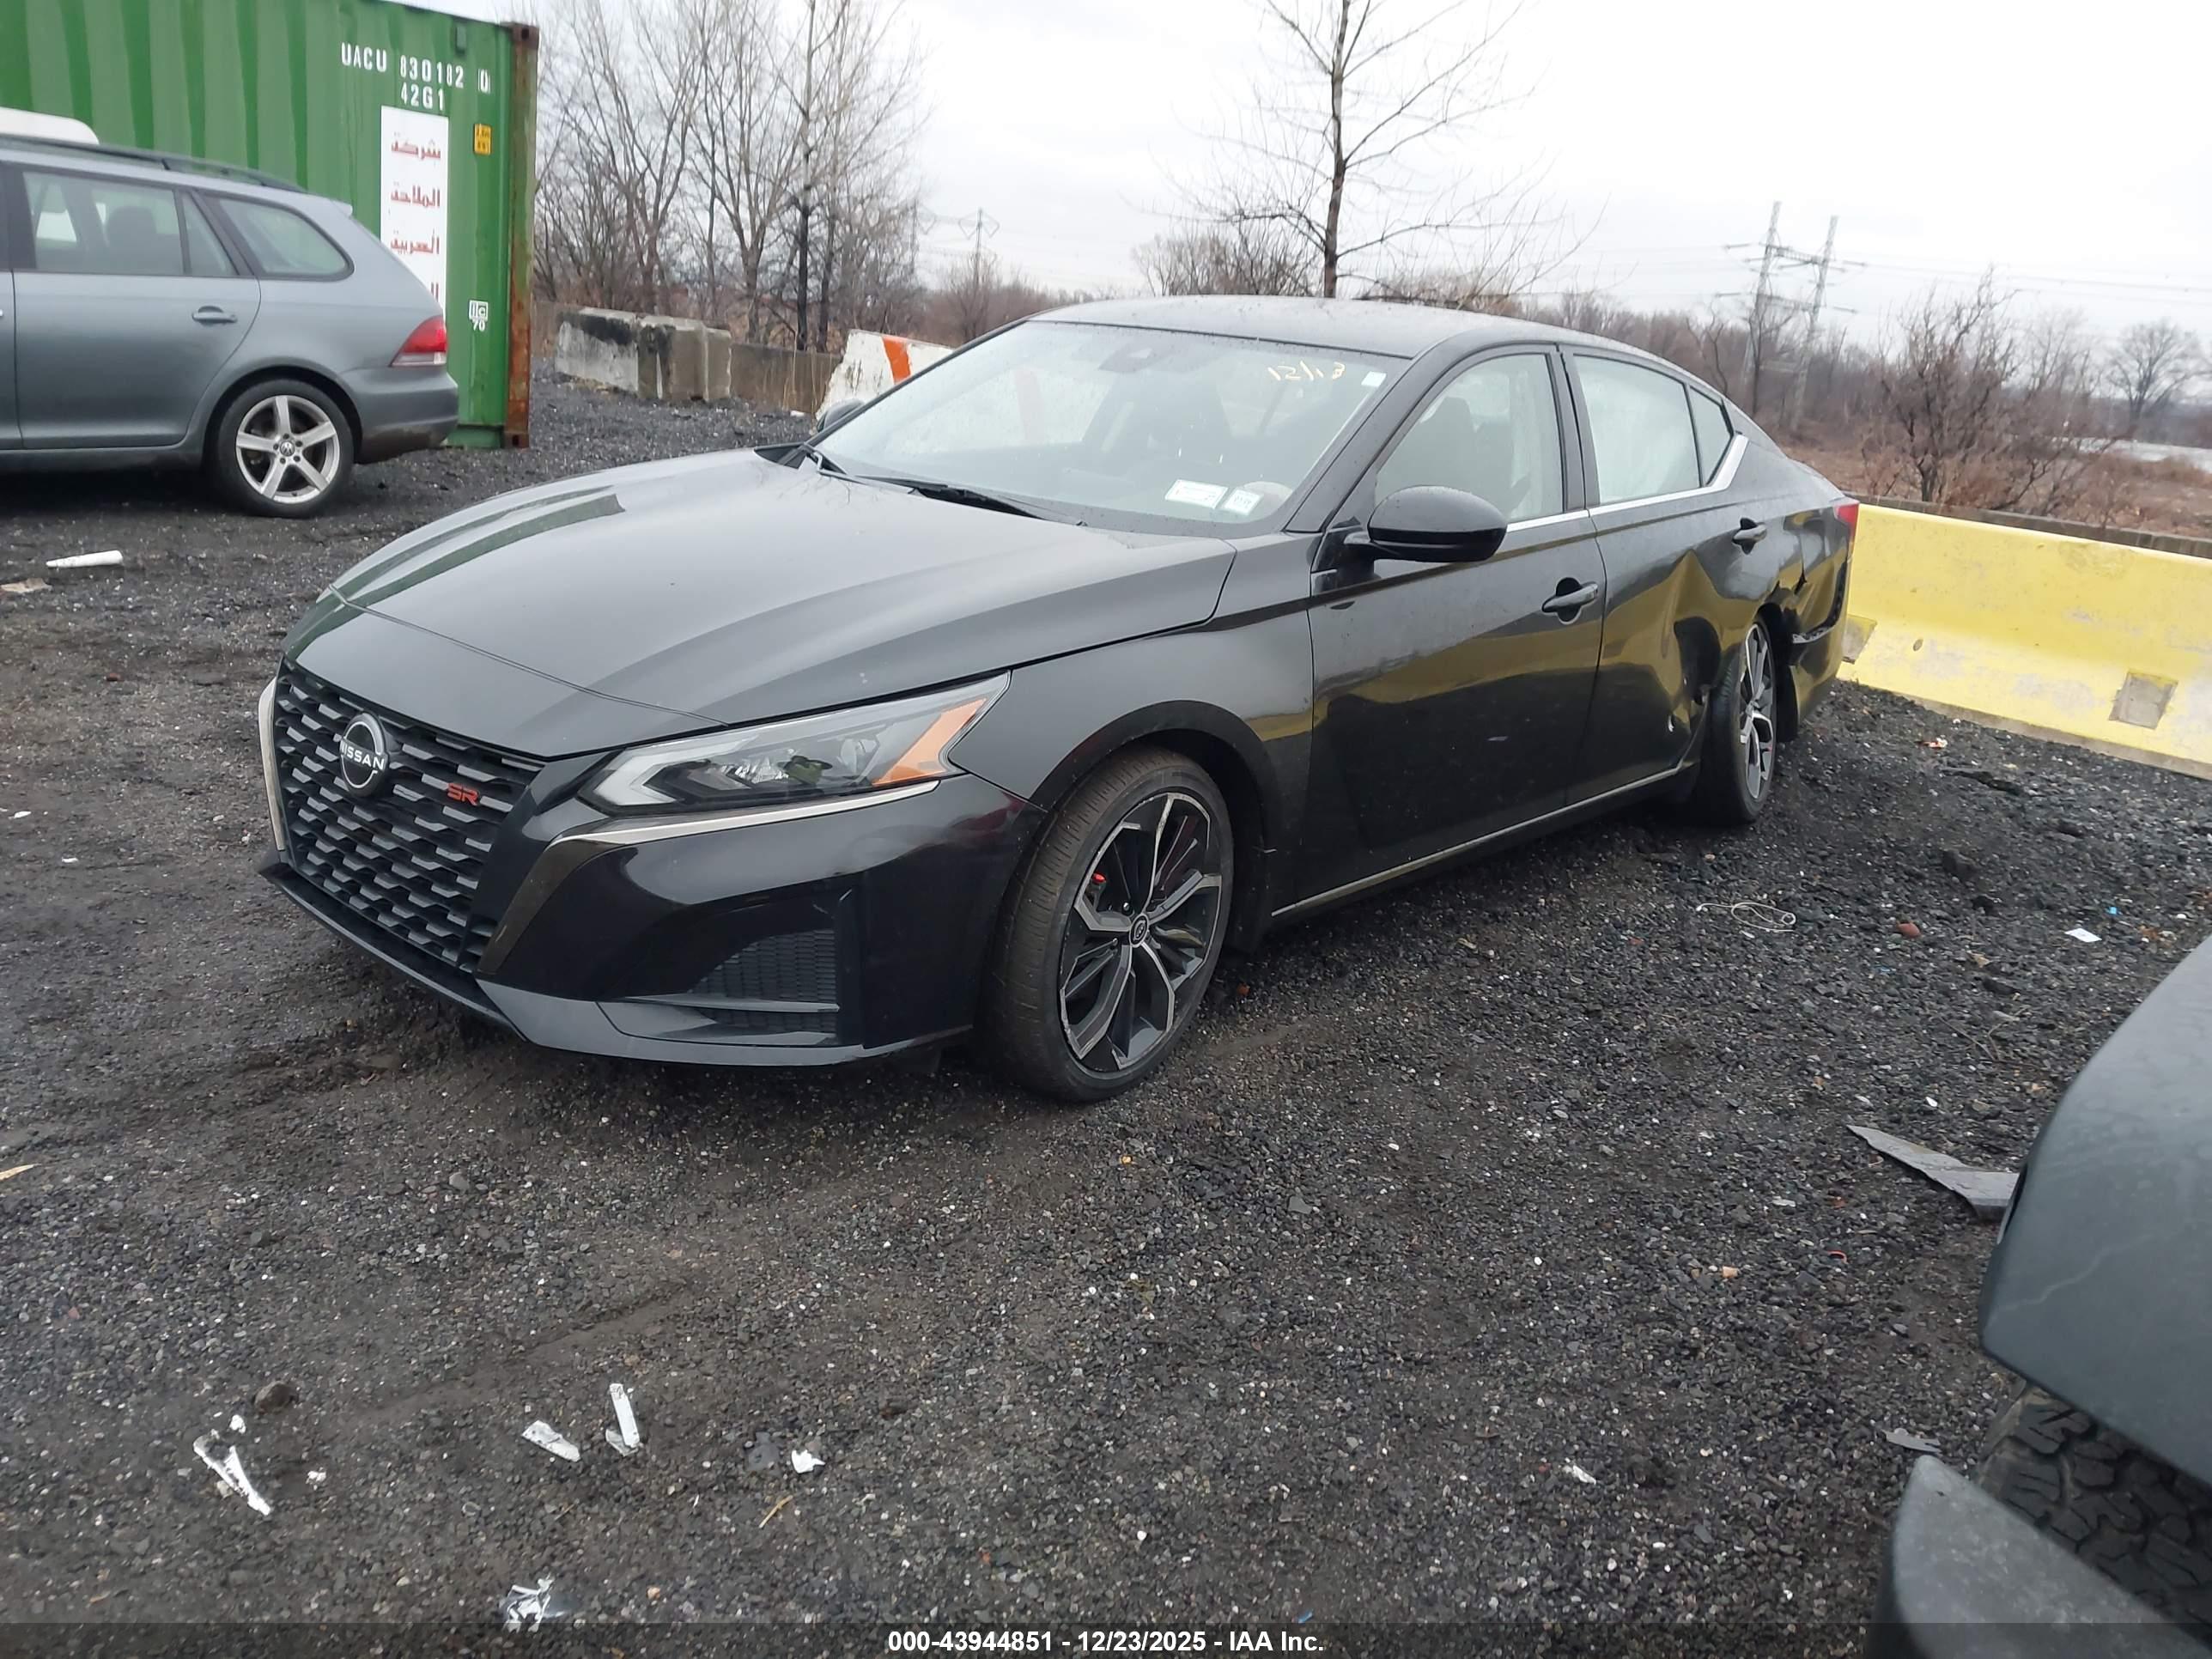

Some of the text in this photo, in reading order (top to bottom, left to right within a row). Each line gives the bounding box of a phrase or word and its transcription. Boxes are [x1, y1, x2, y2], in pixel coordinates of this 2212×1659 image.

[341, 41, 388, 73] UACU
[399, 54, 465, 88] 830182
[400, 82, 445, 111] 42G1
[340, 739, 386, 771] NISSAN
[447, 782, 479, 806] SR
